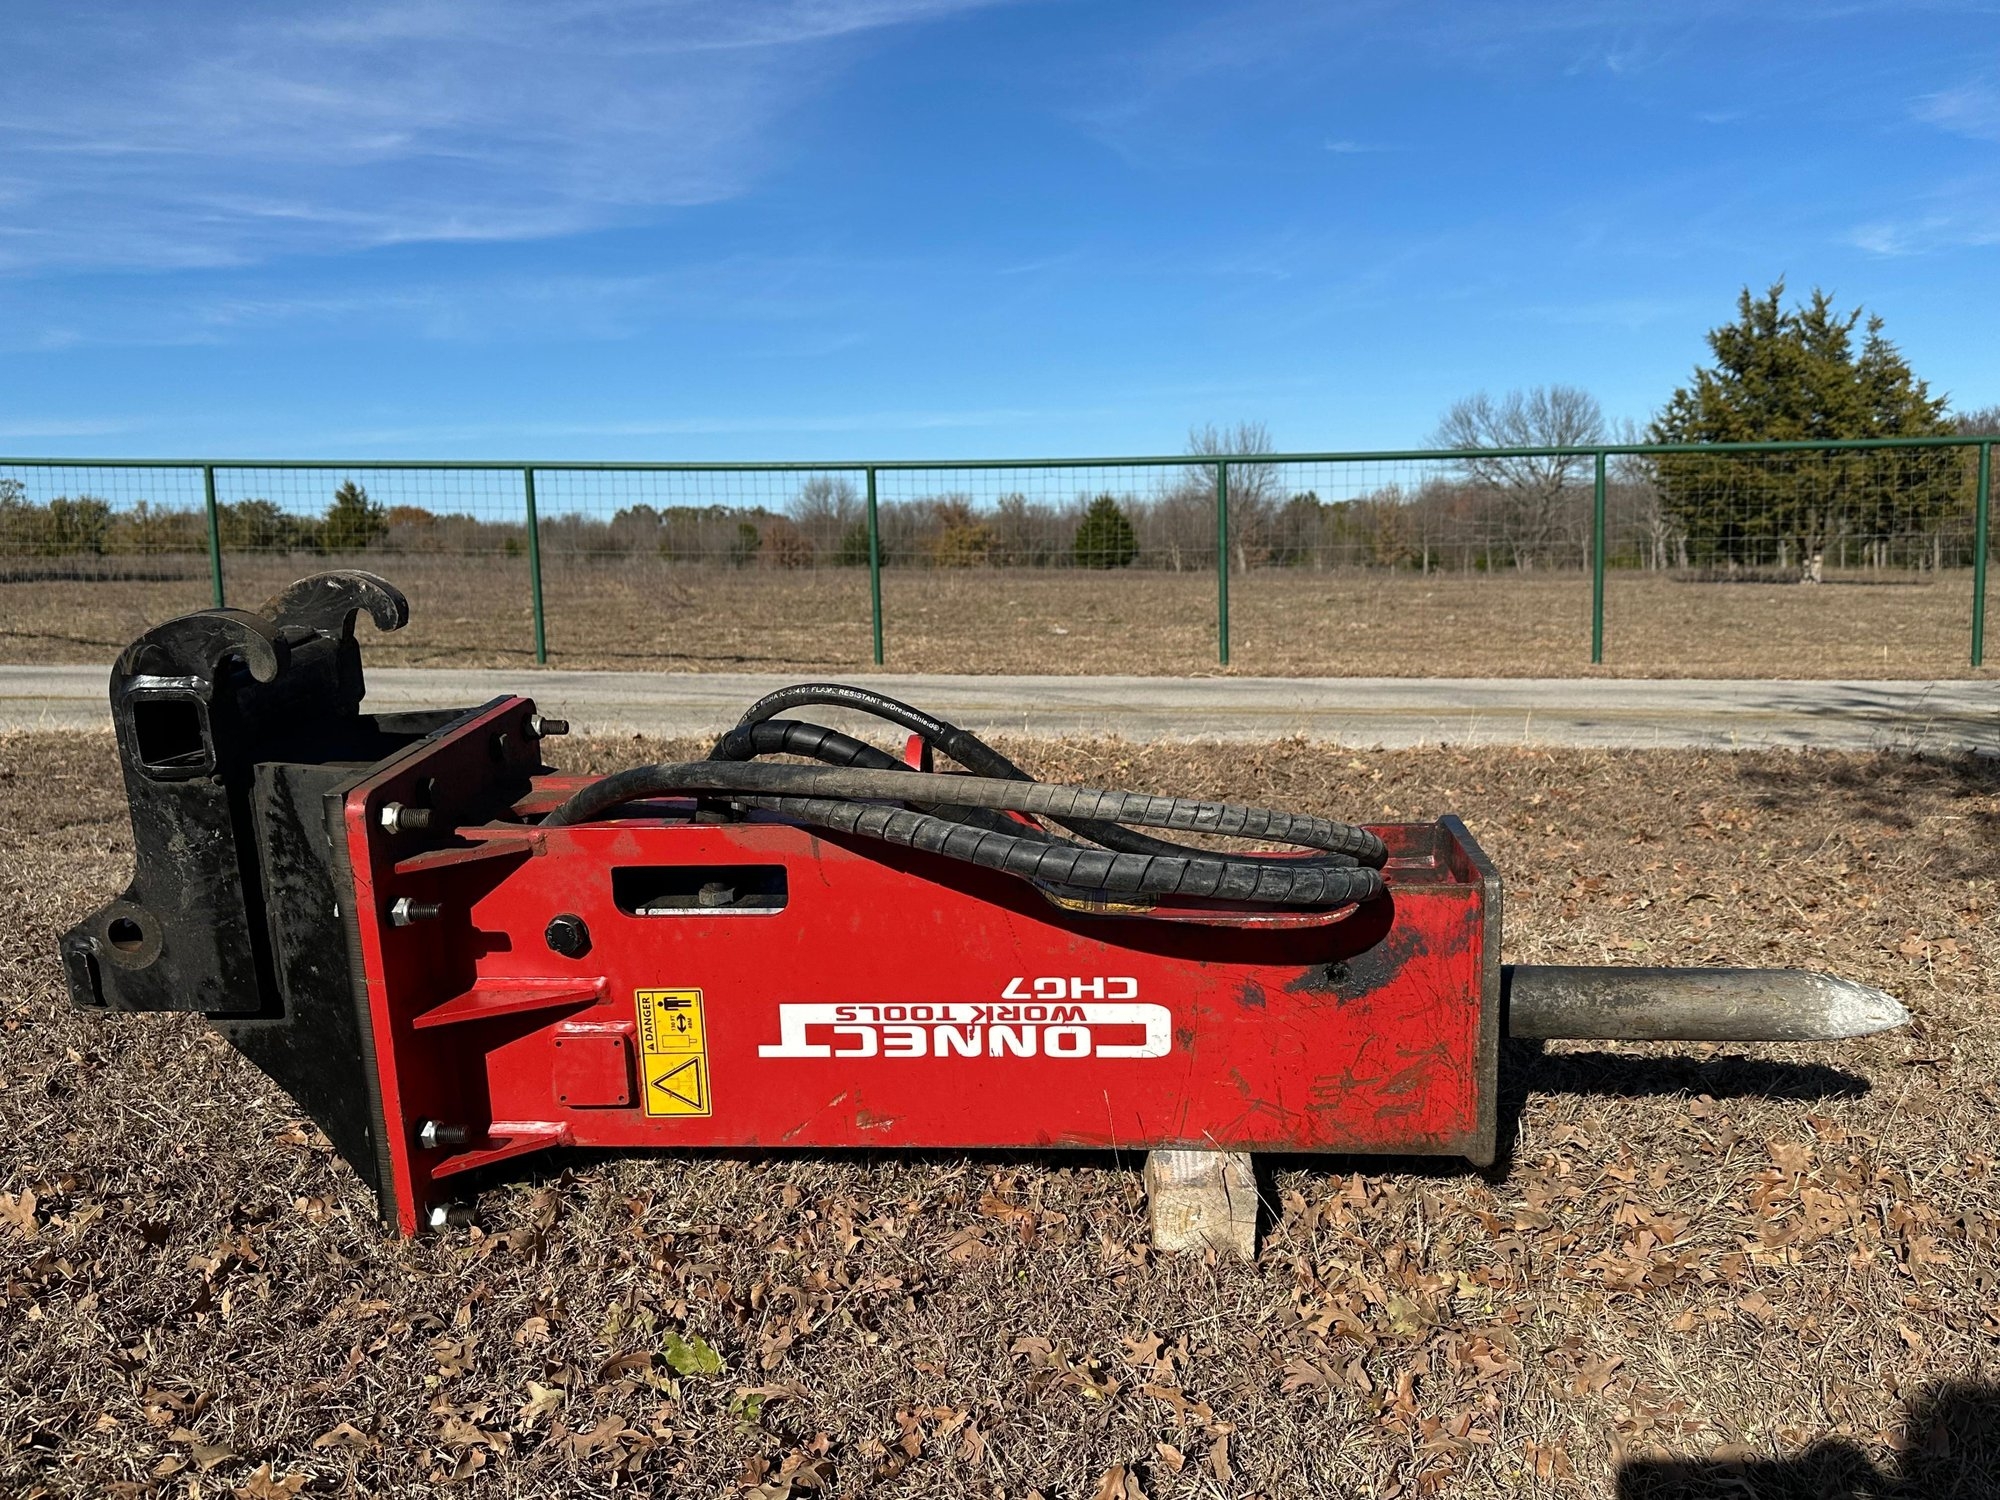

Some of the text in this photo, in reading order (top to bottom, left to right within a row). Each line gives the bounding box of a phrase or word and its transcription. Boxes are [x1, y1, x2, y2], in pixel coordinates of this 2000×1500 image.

[838, 689, 882, 705] RESISTANT
[1001, 977, 1138, 1000] CHG7
[642, 997, 654, 1041] DANGER
[835, 1005, 1087, 1023] WORK TOOLS
[758, 1003, 1172, 1058] CONNECT
